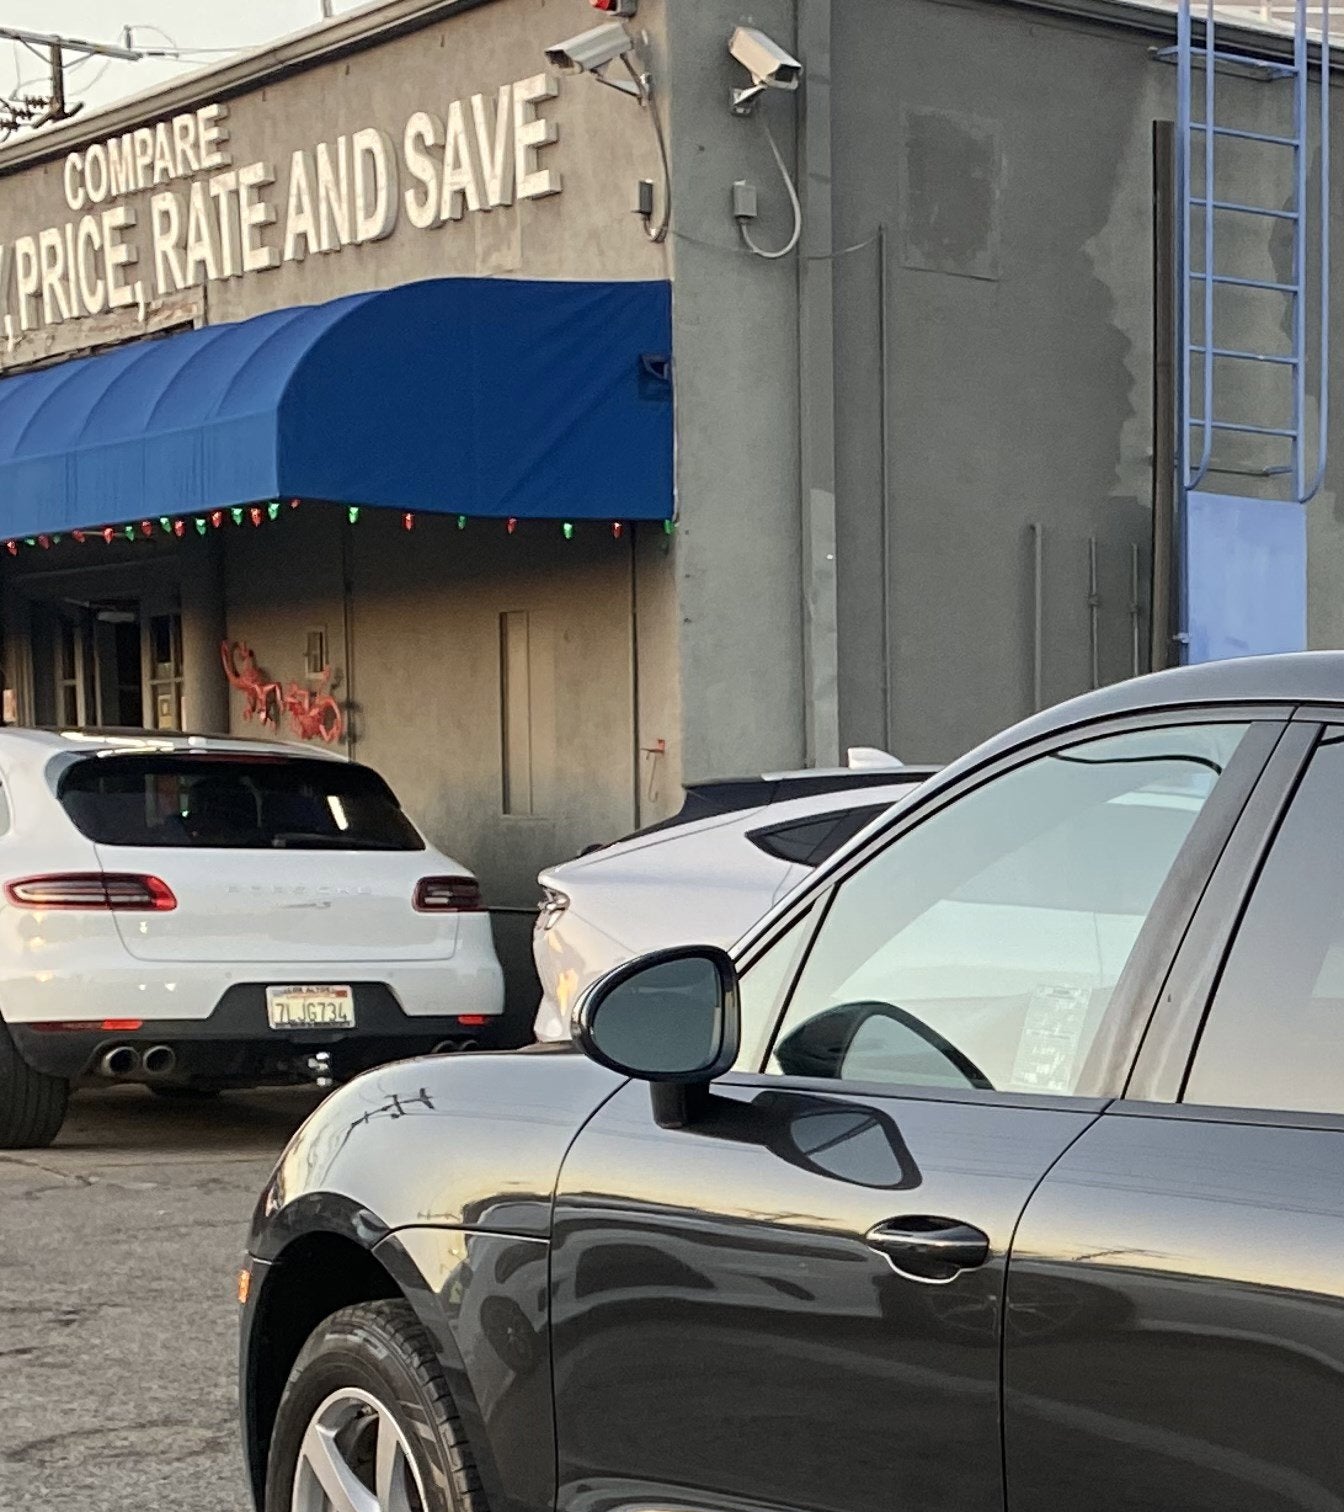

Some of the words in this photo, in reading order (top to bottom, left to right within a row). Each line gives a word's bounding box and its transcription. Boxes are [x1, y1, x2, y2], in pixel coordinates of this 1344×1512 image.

[15, 205, 145, 331] PRICE,
[151, 161, 281, 295] RATE
[283, 127, 397, 262] AND
[403, 72, 562, 230] SAVE
[64, 103, 232, 210] COMPARE
